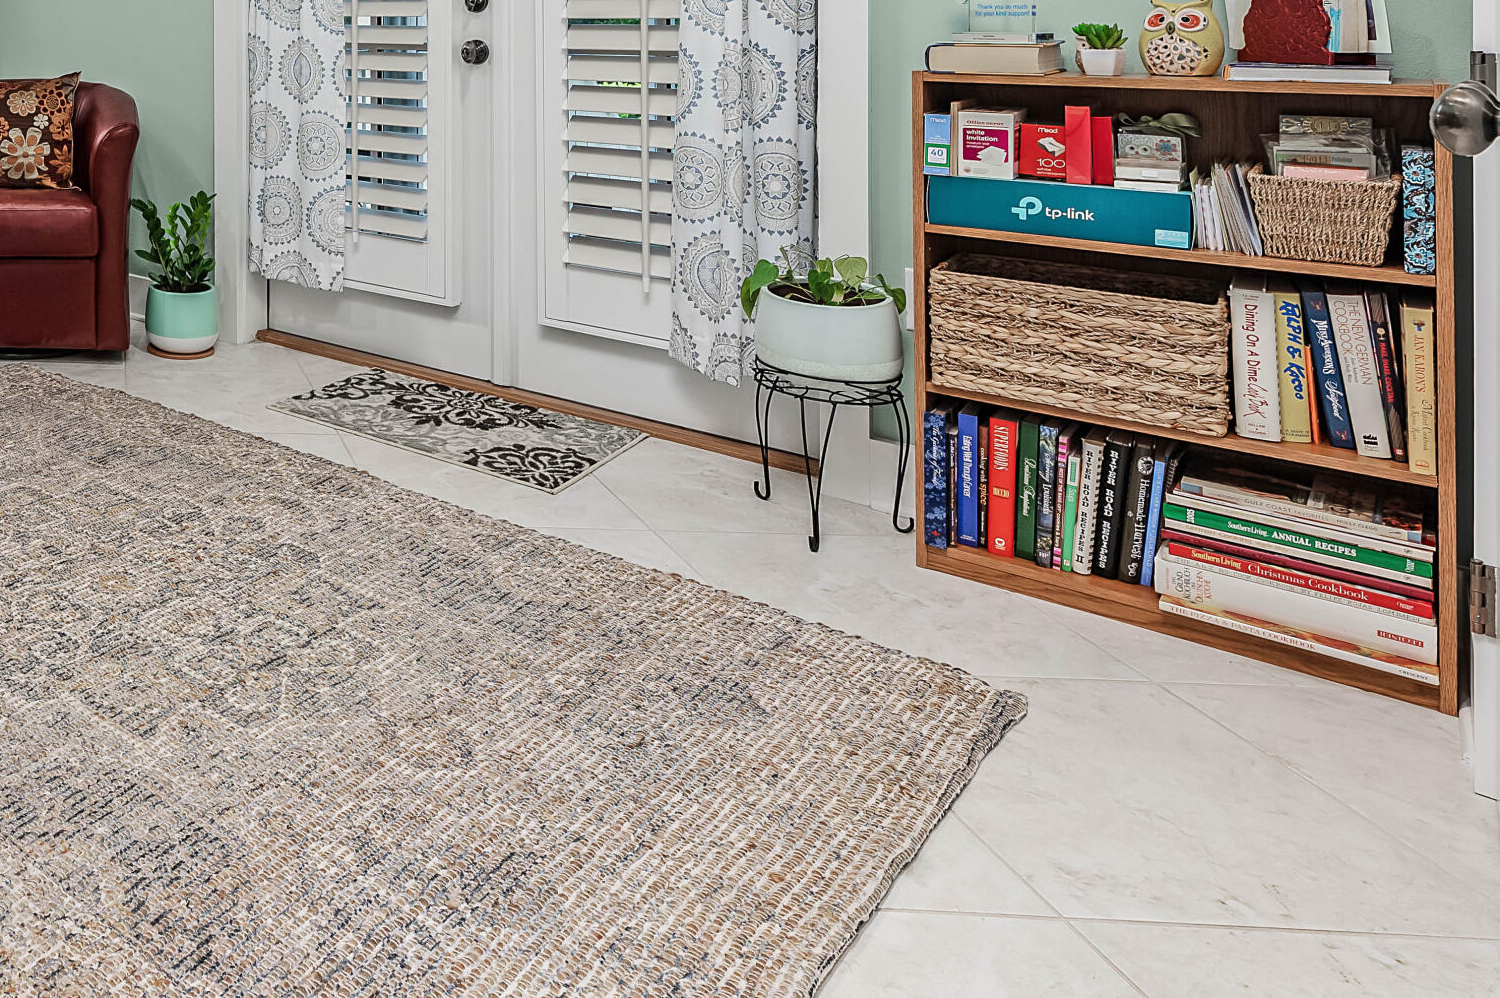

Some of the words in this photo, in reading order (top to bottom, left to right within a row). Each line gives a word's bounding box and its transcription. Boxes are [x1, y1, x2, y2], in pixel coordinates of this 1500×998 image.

[930, 148, 944, 157] 40
[1036, 158, 1066, 168] 100
[1045, 207, 1095, 221] tp-link
[1242, 303, 1259, 333] Dining
[1346, 300, 1361, 316] THE
[1278, 300, 1303, 346] RALPH
[1333, 300, 1353, 354] COOKBOOK
[1350, 317, 1366, 344] NEW
[1246, 334, 1260, 348] On
[1246, 349, 1256, 357] A
[1286, 346, 1302, 359] &
[1413, 334, 1425, 353] JAN
[1246, 359, 1261, 383] Dime
[1355, 345, 1373, 386] GERMAN
[1414, 354, 1426, 393] KARON'S
[1325, 379, 1344, 422] Seafood
[962, 435, 973, 451] Eating
[994, 425, 1009, 471] SUPERFOODS
[963, 451, 973, 462] Well
[979, 447, 988, 469] cooking
[1084, 450, 1094, 480] RIVER
[1107, 449, 1119, 486] RIVER
[962, 461, 973, 481] Through
[980, 470, 988, 483] with
[962, 481, 972, 498] Cancer
[979, 483, 989, 505] spice
[1081, 483, 1091, 508] ROAD
[1135, 478, 1150, 523] Homemade
[1104, 488, 1115, 517] ROAD
[1244, 498, 1263, 507] GULF
[1266, 503, 1292, 513] COAST
[1077, 511, 1088, 552] RECIPES
[1131, 522, 1146, 559] Harvest
[1227, 521, 1252, 533] Southern
[1252, 524, 1269, 537] Living
[1272, 531, 1312, 546] ANNUAL
[1314, 540, 1357, 557] RECIPES
[1099, 520, 1111, 569] RECIPES
[1075, 554, 1085, 564] II
[1146, 550, 1154, 567] CHILD
[1191, 550, 1220, 563] Southern
[1220, 557, 1242, 569] Living
[1248, 563, 1305, 585] Christmas
[1308, 577, 1369, 601] Cookbook
[1171, 606, 1188, 614] THE
[1190, 611, 1219, 623] PIZZA
[1231, 622, 1262, 635] PASTA
[1262, 632, 1316, 651] COOKBOOK
